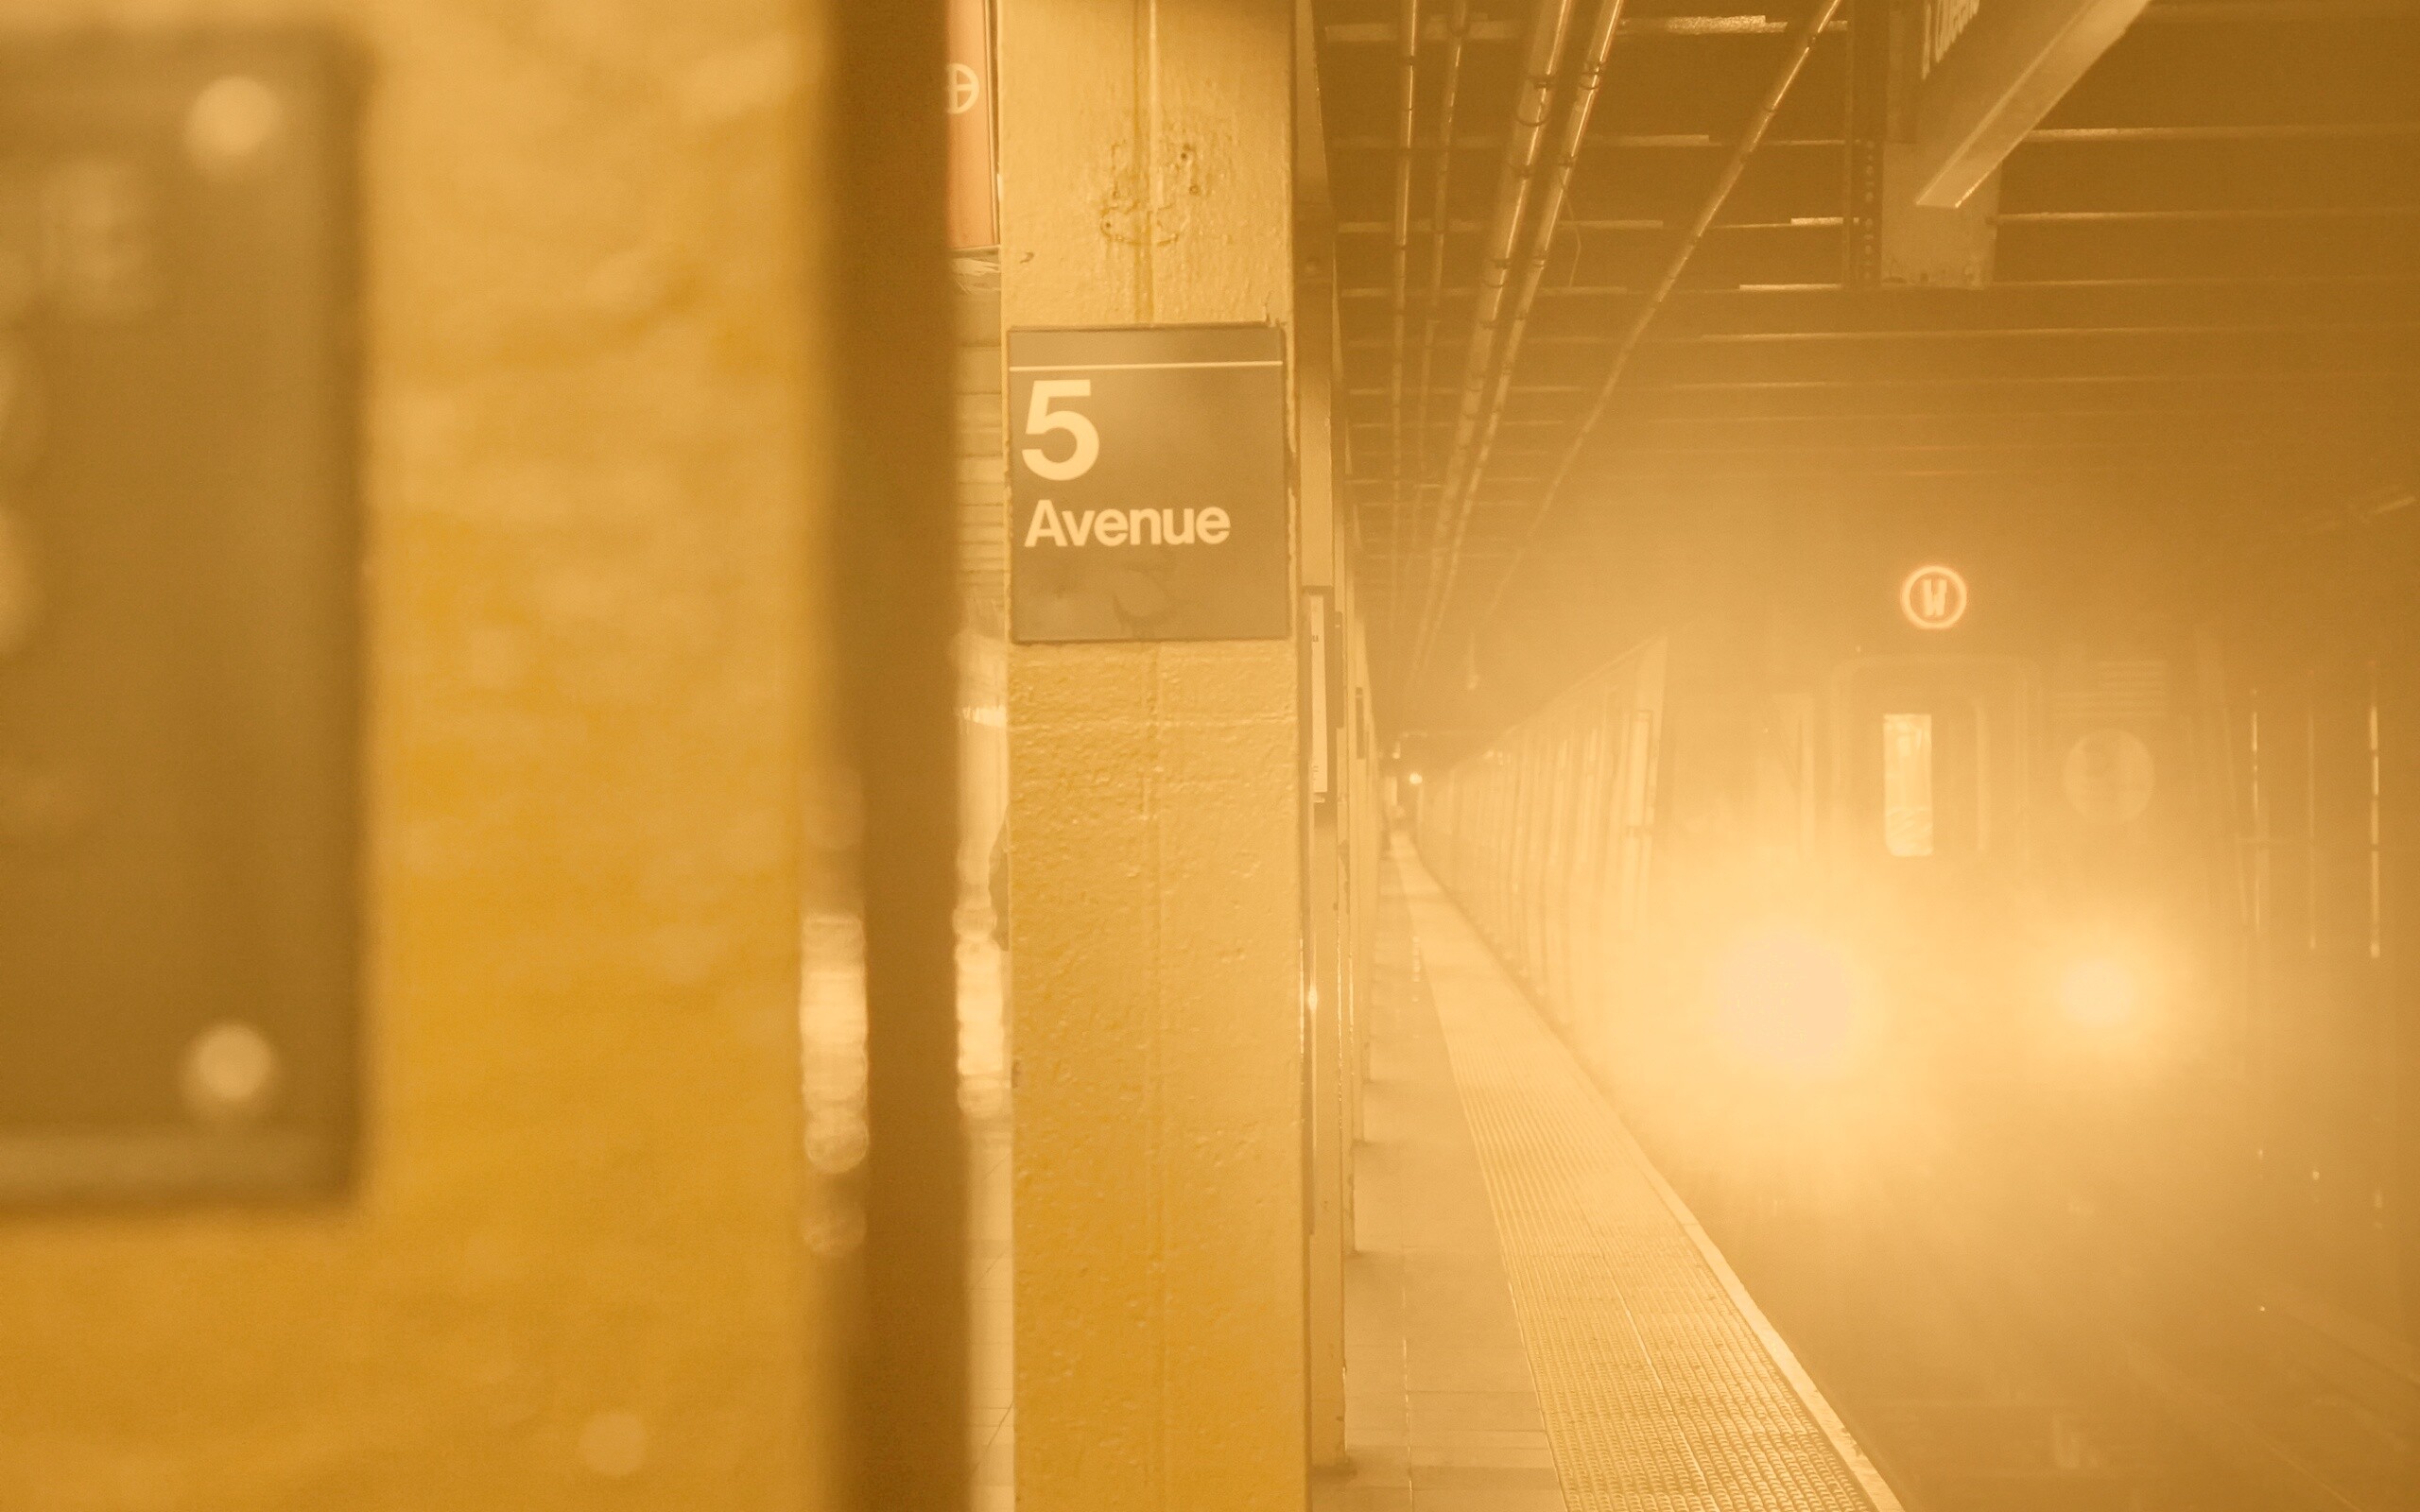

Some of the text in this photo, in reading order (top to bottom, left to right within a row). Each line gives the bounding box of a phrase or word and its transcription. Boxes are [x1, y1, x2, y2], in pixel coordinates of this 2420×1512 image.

[1022, 379, 1099, 481] 5
[1024, 499, 1231, 548] Avenue
[1923, 577, 1947, 617] W
